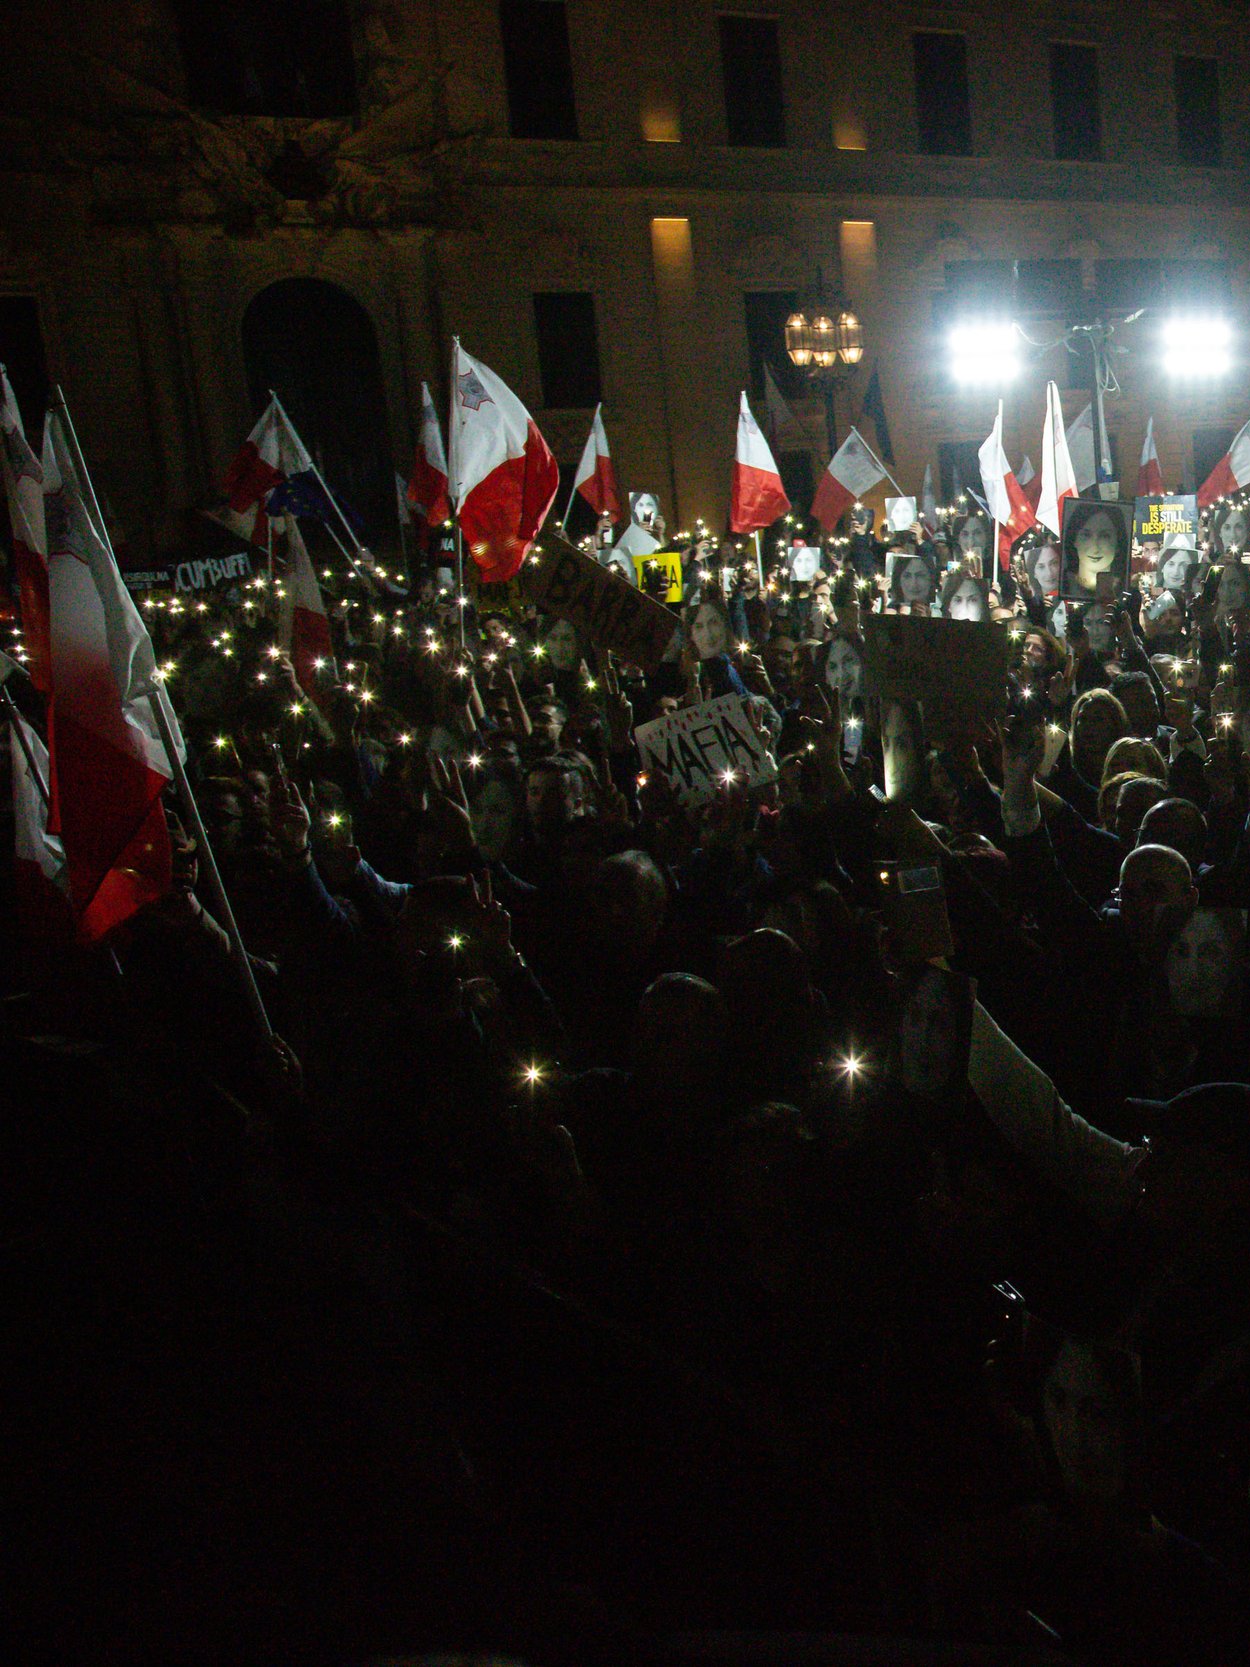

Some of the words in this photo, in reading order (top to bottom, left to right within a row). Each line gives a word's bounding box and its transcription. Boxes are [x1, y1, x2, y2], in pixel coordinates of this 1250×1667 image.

[1150, 511, 1159, 523] IS
[1160, 510, 1184, 522] STILL
[1142, 521, 1192, 535] DESPERATE
[646, 716, 761, 788] MAFIA
